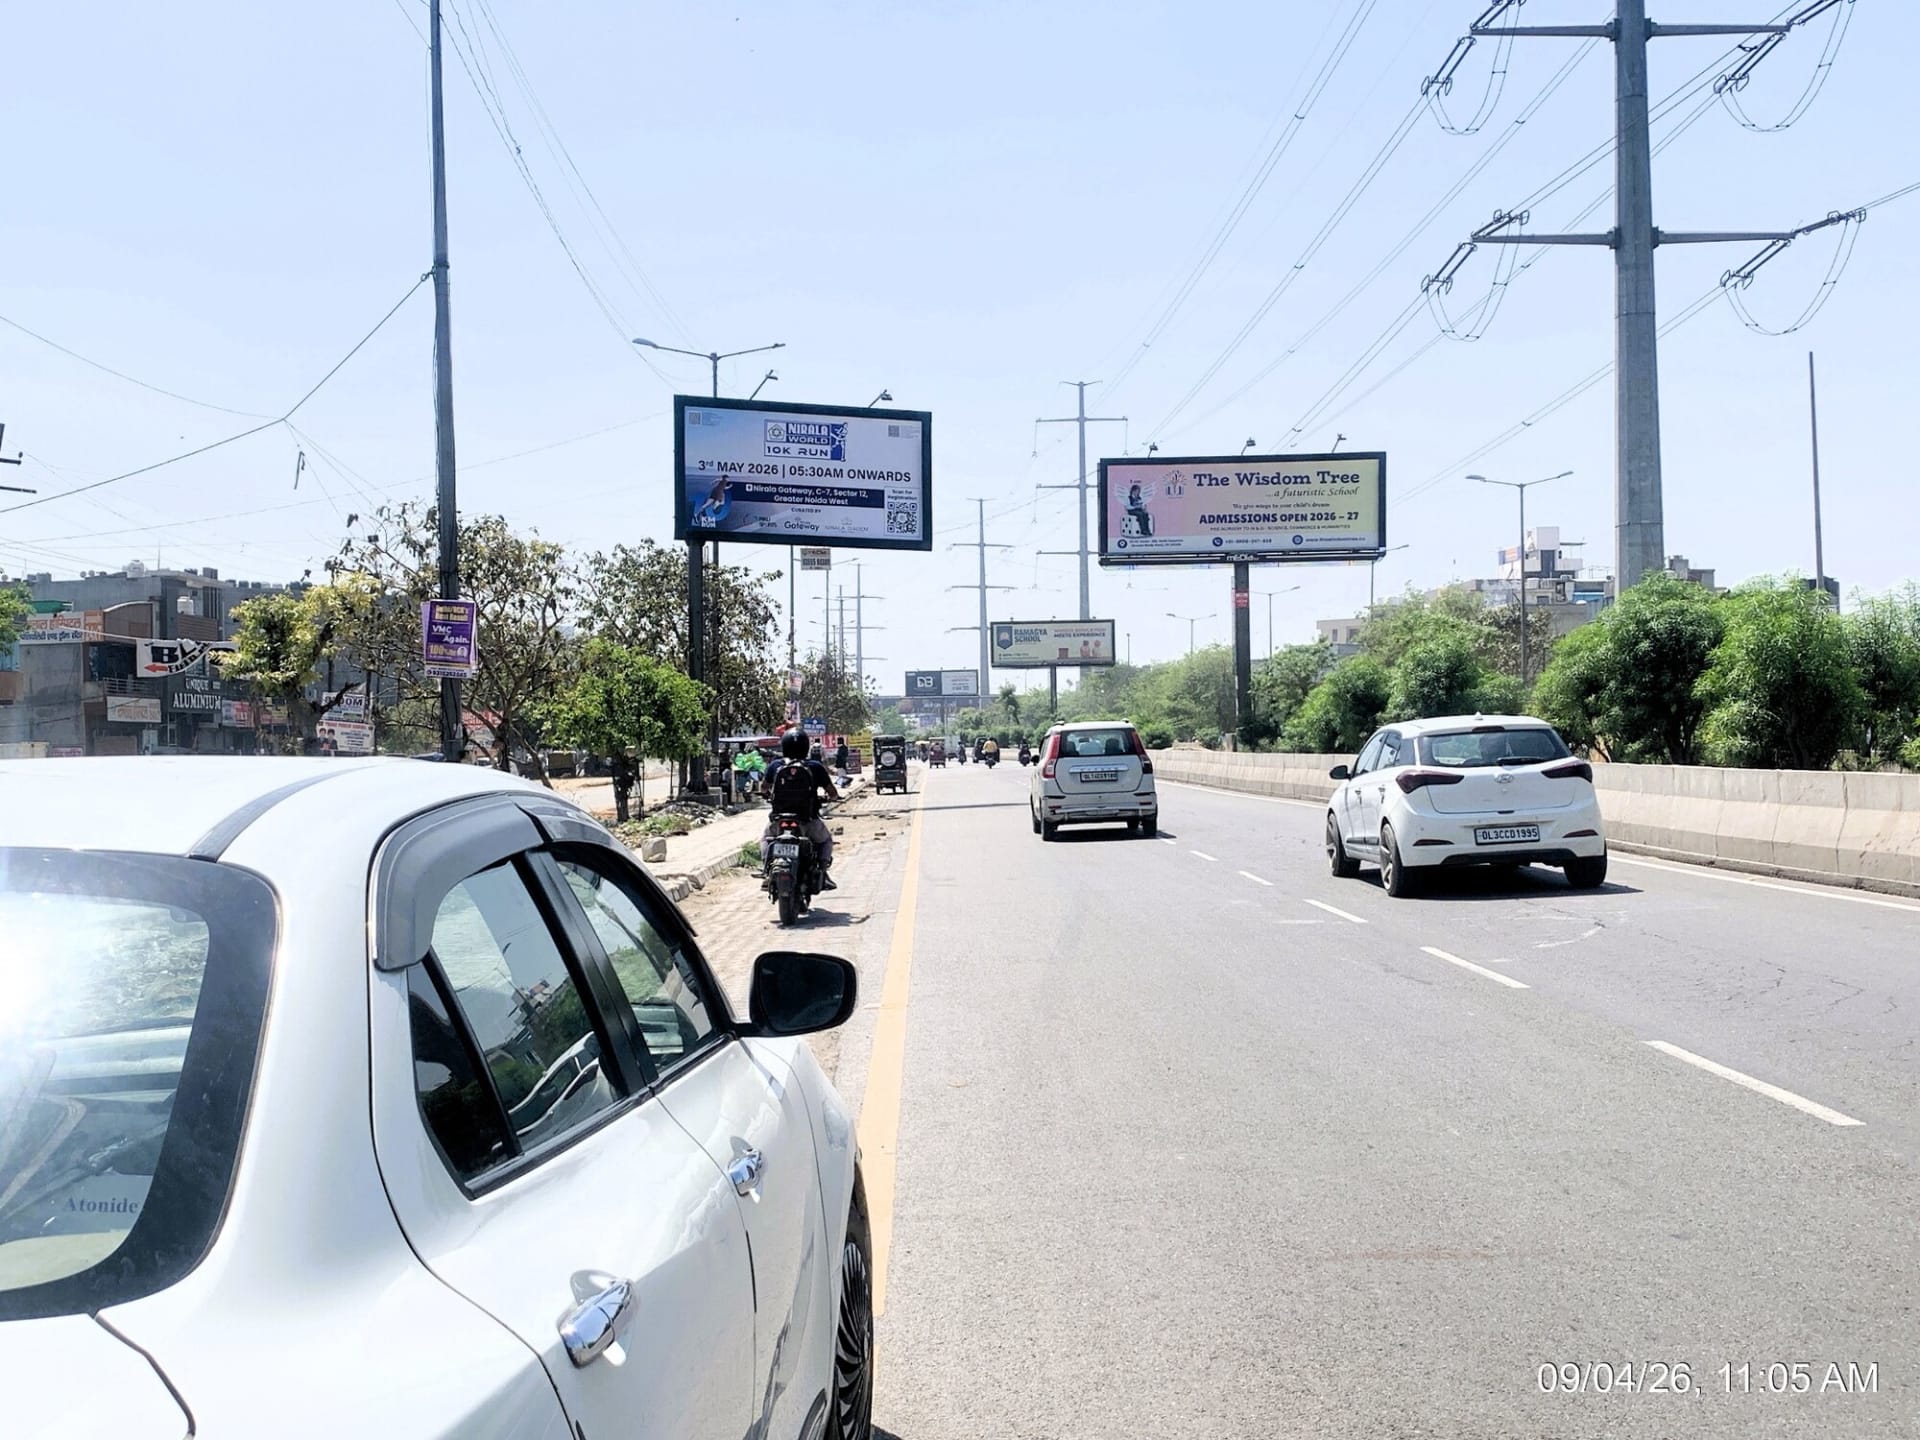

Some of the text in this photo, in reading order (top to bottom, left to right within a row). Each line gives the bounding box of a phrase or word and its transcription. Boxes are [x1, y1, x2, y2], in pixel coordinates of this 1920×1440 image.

[787, 423, 829, 436] NIRALA
[788, 435, 829, 445] WORLD
[767, 445, 829, 457] 10K RUN
[698, 460, 714, 471] 3rd
[717, 461, 745, 473] MAY
[748, 463, 779, 475] 2026
[789, 465, 844, 479] 05:30AM
[847, 468, 911, 482] ONWARDS
[1193, 470, 1360, 487] The Wisdom Tree
[753, 485, 777, 493] Nirala
[778, 486, 815, 496] Gateway,
[833, 489, 857, 497] Sector
[1280, 488, 1326, 500] futuristic
[1327, 486, 1358, 498] School
[774, 495, 803, 503] Greater
[804, 496, 828, 504] Noida
[1199, 513, 1278, 524] ADMISSIONS
[1280, 513, 1308, 522] OPEN
[1310, 511, 1336, 521] 2026
[1346, 511, 1359, 521] 27
[784, 520, 820, 531] Gateway
[432, 624, 452, 634] VMC
[443, 635, 470, 644] Again.
[1014, 635, 1041, 643] SCHOOL
[185, 678, 209, 692] UNIQUE
[173, 692, 221, 710] ALUMINIUM
[65, 1197, 139, 1214] Atonide
